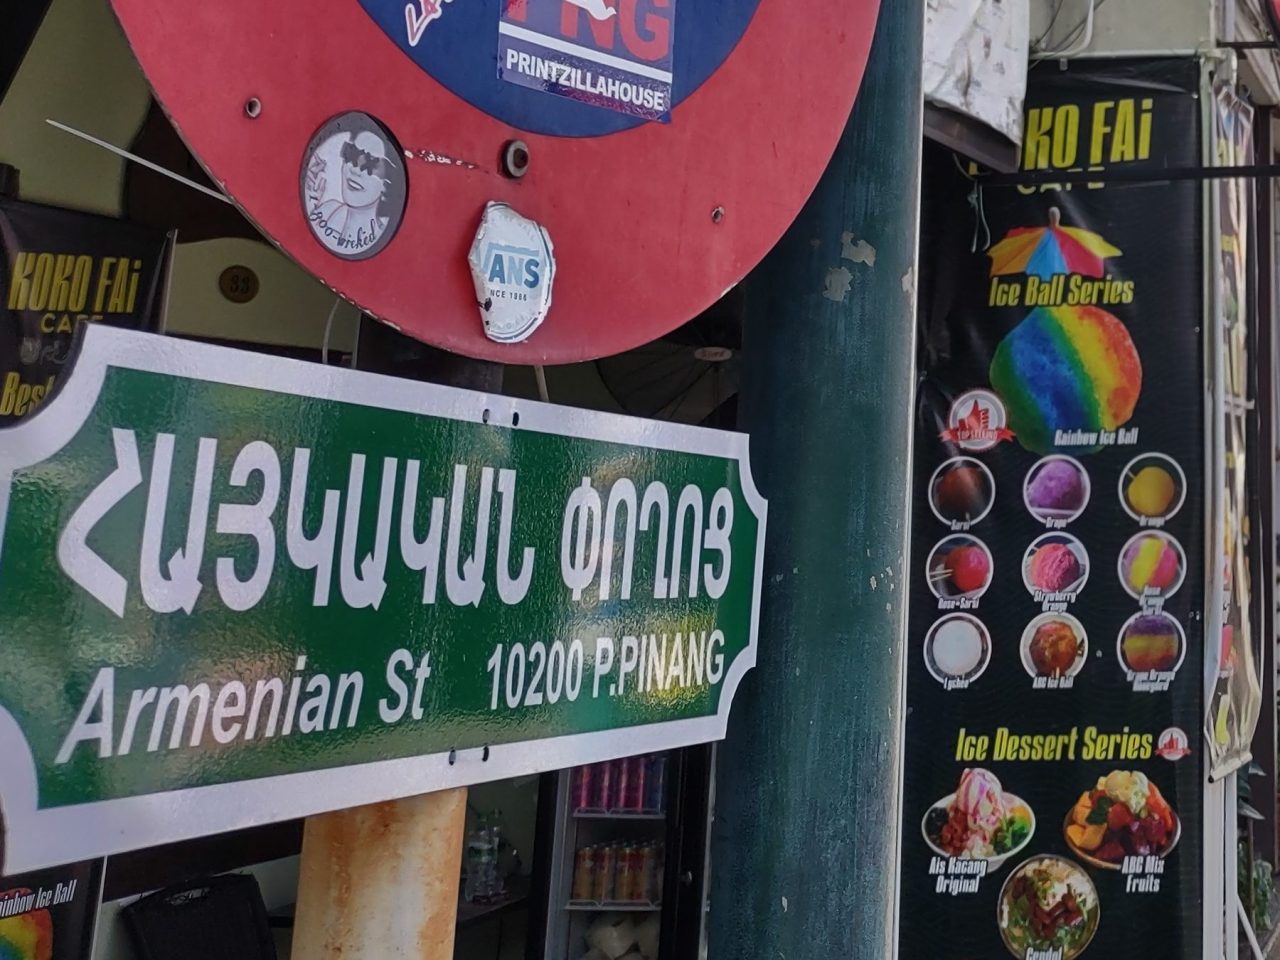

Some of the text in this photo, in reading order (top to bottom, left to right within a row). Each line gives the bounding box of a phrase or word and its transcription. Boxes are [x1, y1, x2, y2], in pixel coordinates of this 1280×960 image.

[506, 49, 664, 111] PRINTZILLAHOUSE
[1024, 104, 1080, 171] KO
[8, 252, 93, 311] KOKO
[989, 274, 1134, 307] Ice Ball Series
[490, 289, 506, 299] NCE
[1054, 427, 1139, 446] Rainbow Ice Ball
[57, 427, 734, 618] ՀԱՅԿԱԿԱՆ ՓՈՂՈՑ
[1034, 590, 1077, 603] Strawberry
[1042, 601, 1068, 612] Orange
[55, 628, 726, 765] Armenian St 10200 P.PINANG
[956, 726, 1153, 761] Ice Dessert Series
[928, 857, 987, 878] Ais Kacang
[1122, 856, 1165, 874] ABC Mix
[36, 887, 53, 909] Ice
[53, 879, 77, 905] Ball
[936, 875, 980, 896] Original
[1126, 874, 1161, 893] Fruits
[1025, 946, 1063, 960] Cendol
